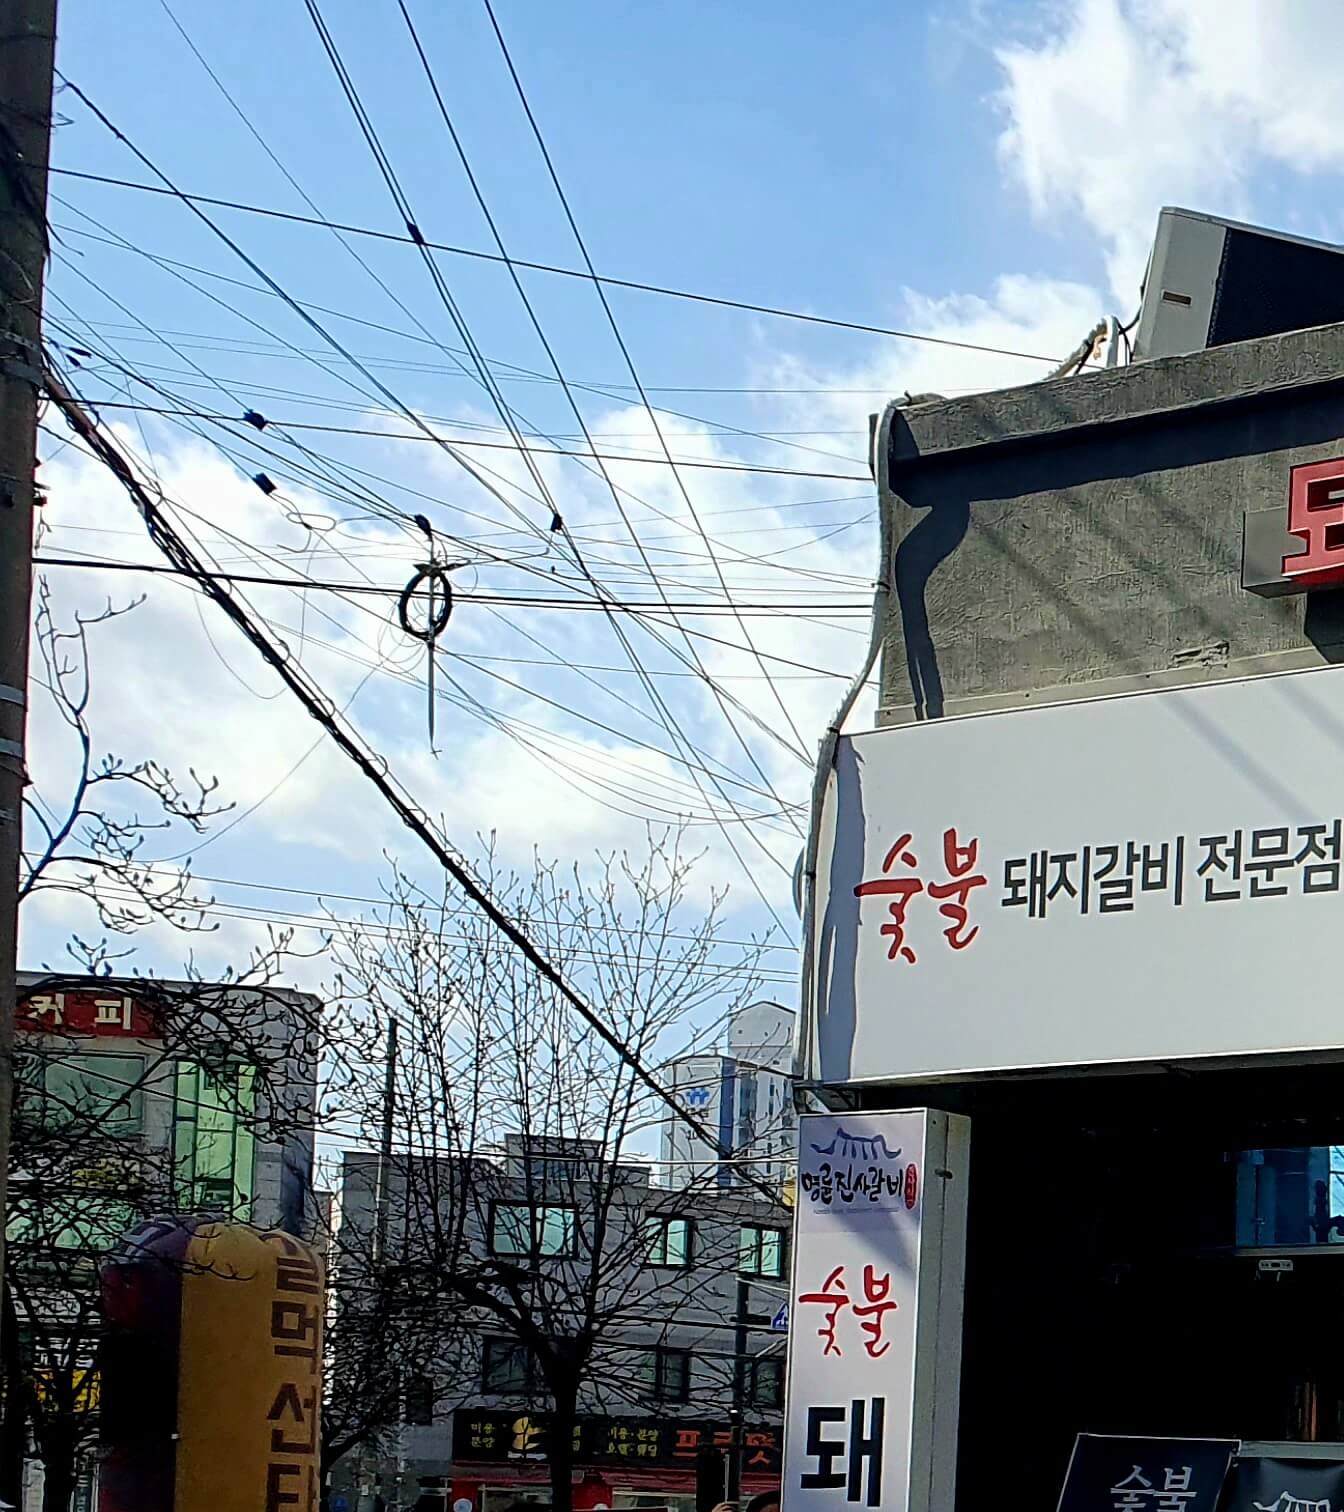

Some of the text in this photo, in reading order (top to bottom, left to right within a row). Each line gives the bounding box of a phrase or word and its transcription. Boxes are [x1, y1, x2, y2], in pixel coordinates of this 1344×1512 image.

[854, 819, 1343, 963] 숯불 돼지갈비 전문점
[28, 993, 133, 1030] 커피
[802, 1162, 903, 1204] 명륜진사갈비
[799, 1265, 897, 1357] 숯불
